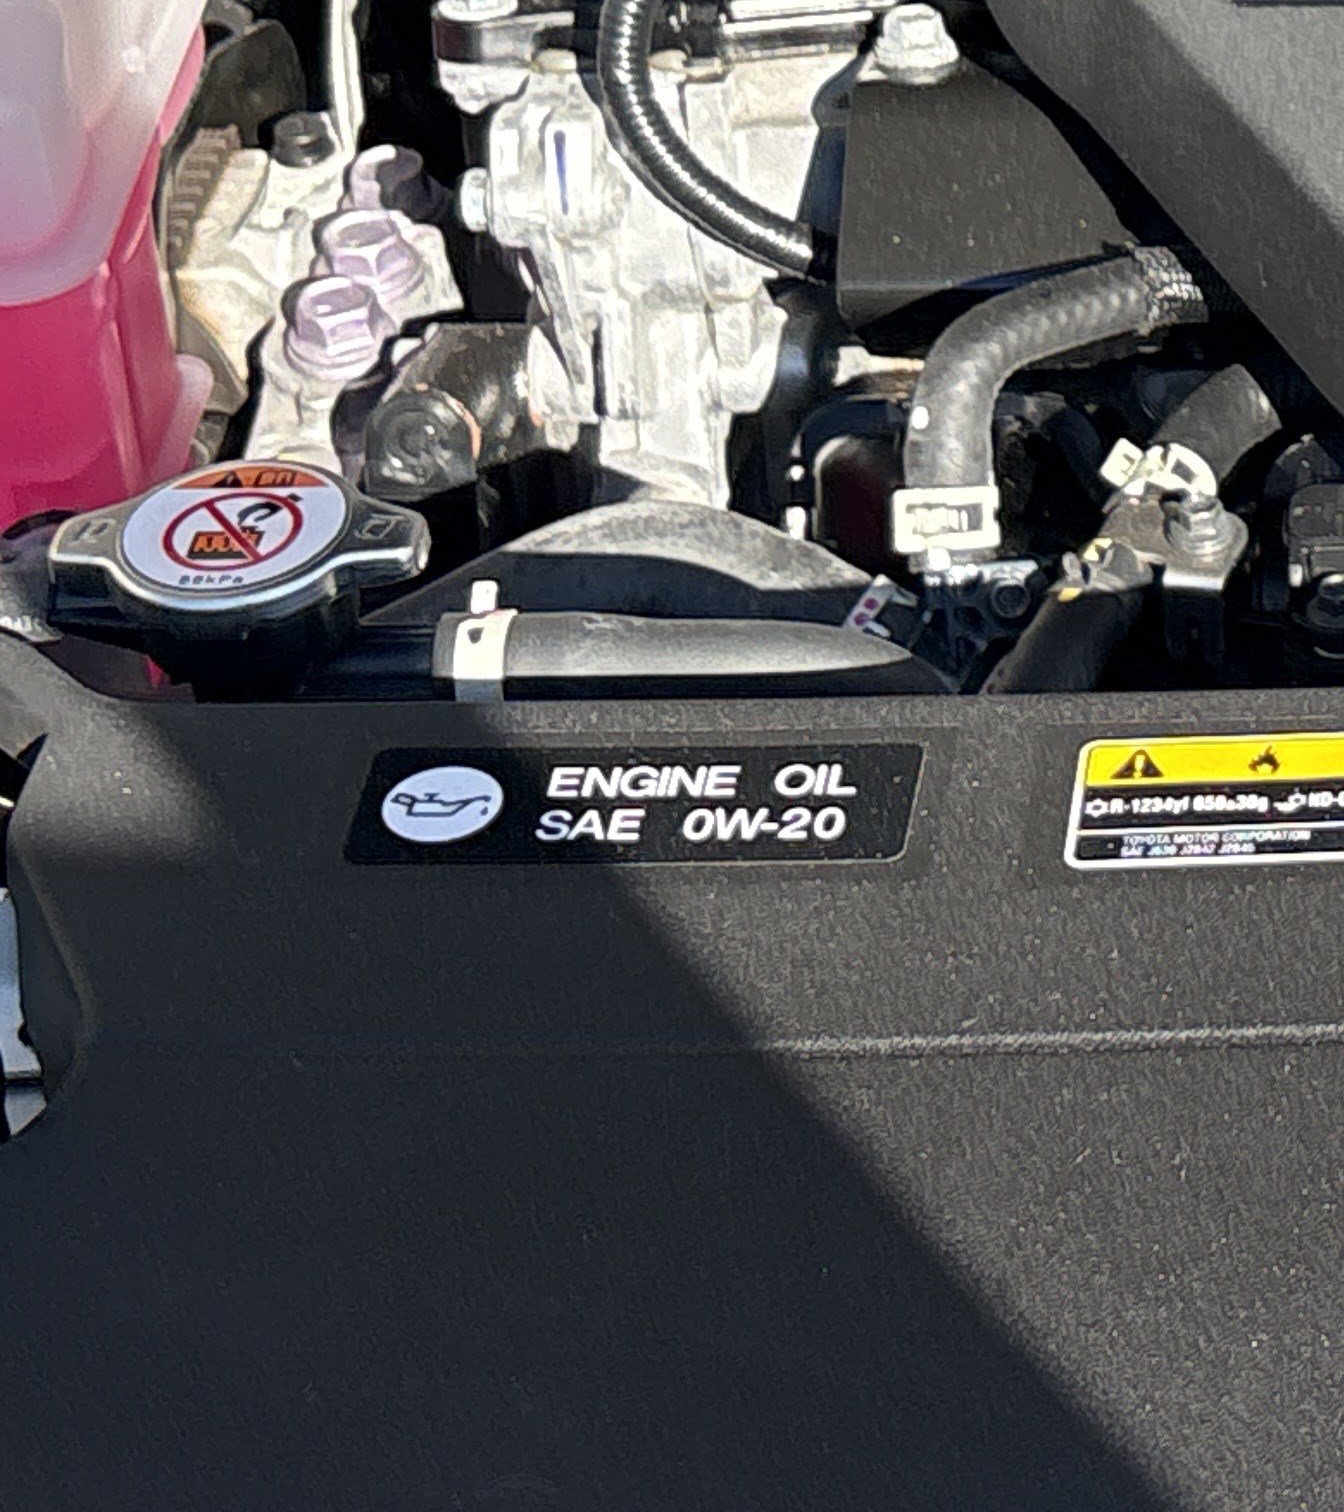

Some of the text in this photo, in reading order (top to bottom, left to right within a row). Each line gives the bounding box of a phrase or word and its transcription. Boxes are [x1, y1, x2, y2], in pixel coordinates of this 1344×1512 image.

[546, 763, 858, 798] ENGINE OIL
[535, 806, 847, 841] SAE 0W-20
